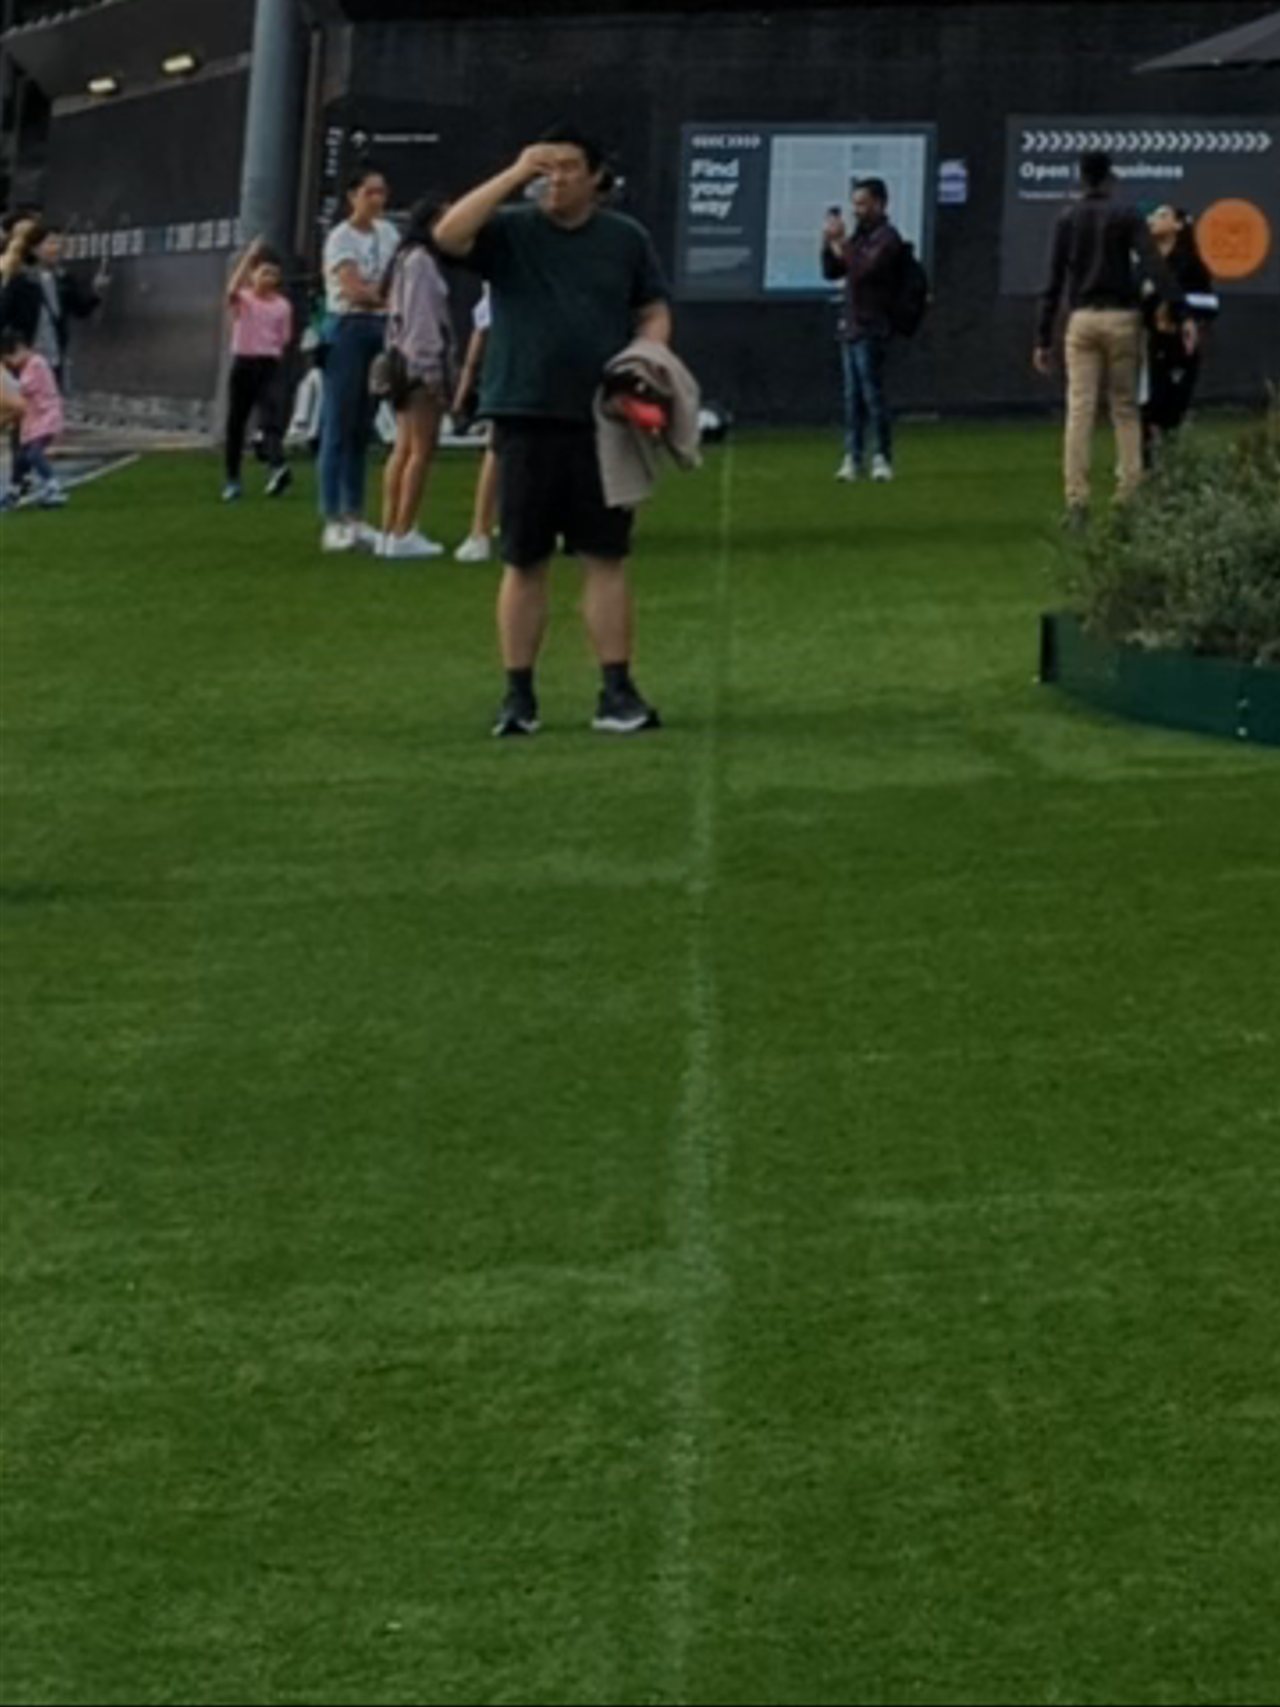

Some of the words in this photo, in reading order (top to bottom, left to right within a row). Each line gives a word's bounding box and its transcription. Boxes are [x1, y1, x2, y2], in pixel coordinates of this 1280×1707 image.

[690, 158, 740, 178] Find
[1019, 161, 1072, 182] Open
[1110, 159, 1184, 180] usiness
[688, 181, 740, 200] your
[688, 200, 732, 220] way
